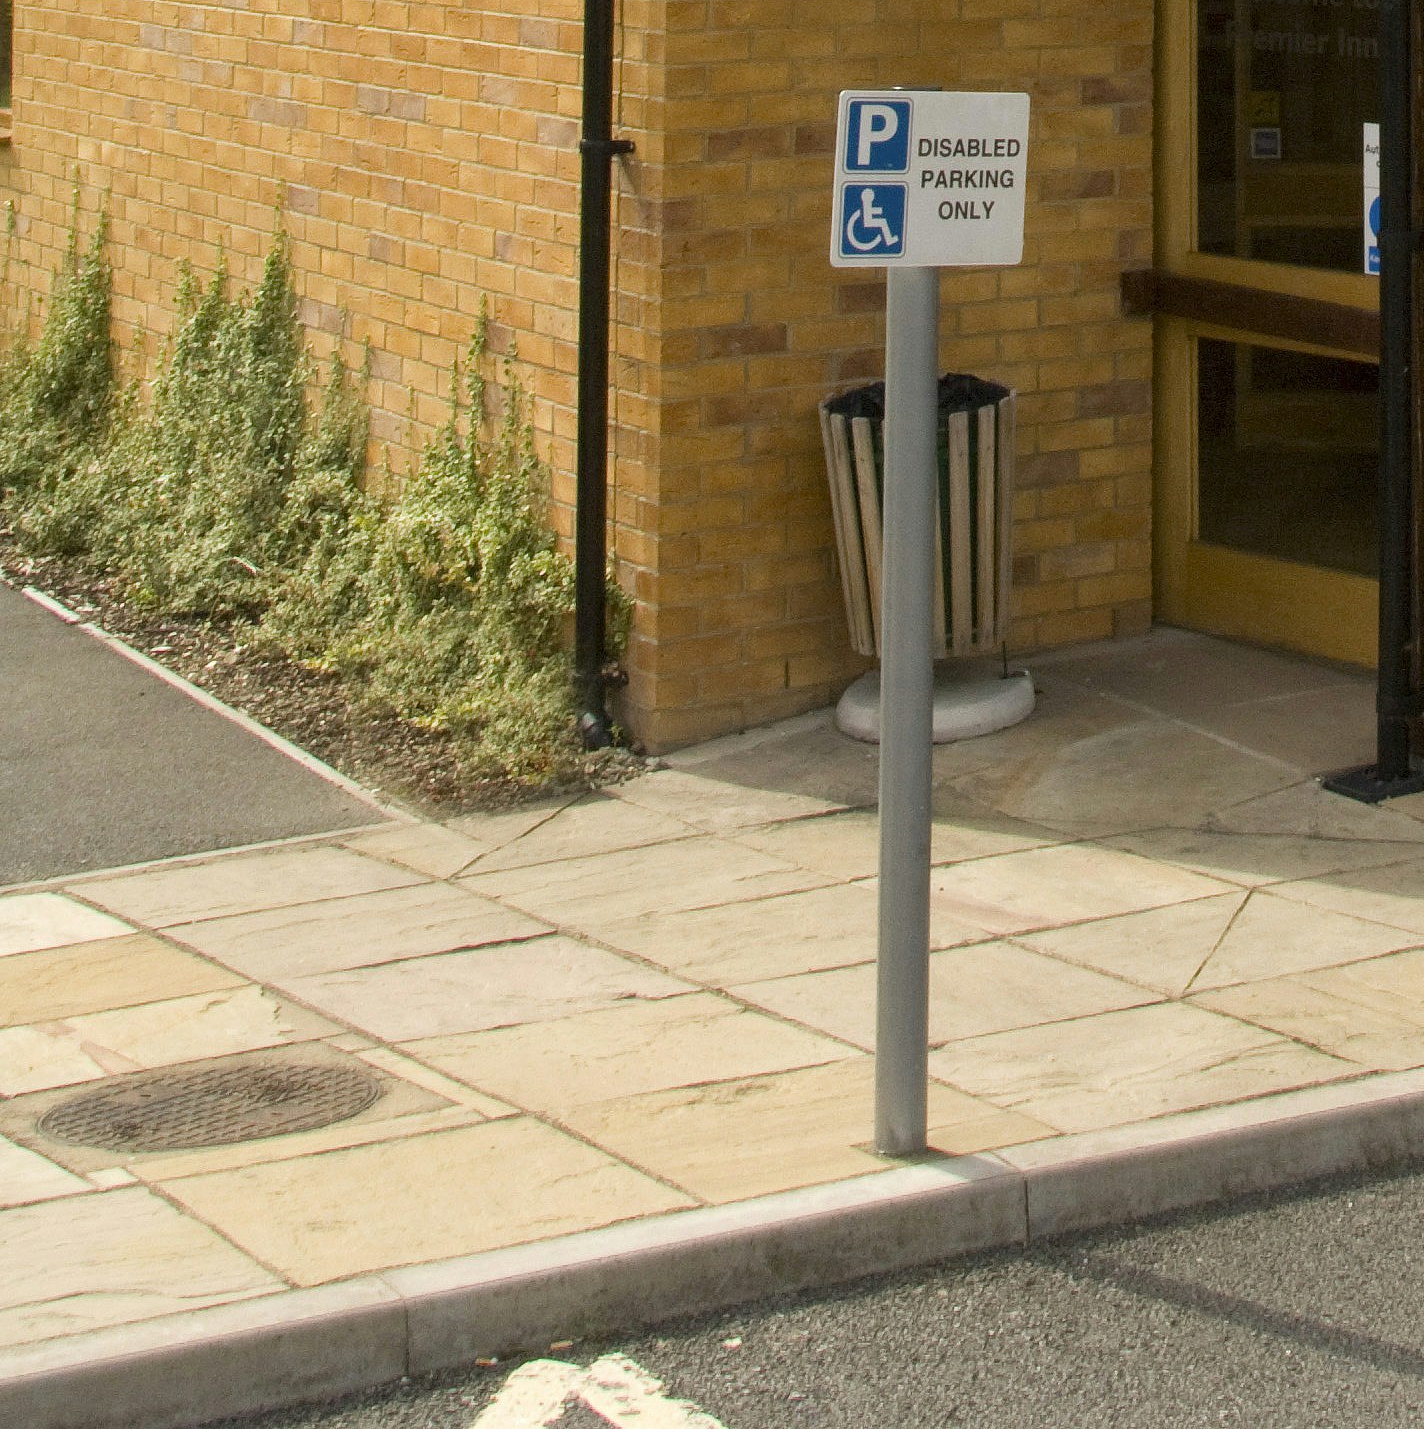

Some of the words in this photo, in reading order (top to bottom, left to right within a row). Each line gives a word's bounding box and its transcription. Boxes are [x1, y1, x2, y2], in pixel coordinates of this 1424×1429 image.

[1337, 27, 1379, 58] Inn
[857, 104, 899, 166] P
[918, 138, 1020, 157] DISABLED
[921, 170, 1014, 189] PARKING
[938, 201, 995, 220] ONLY
